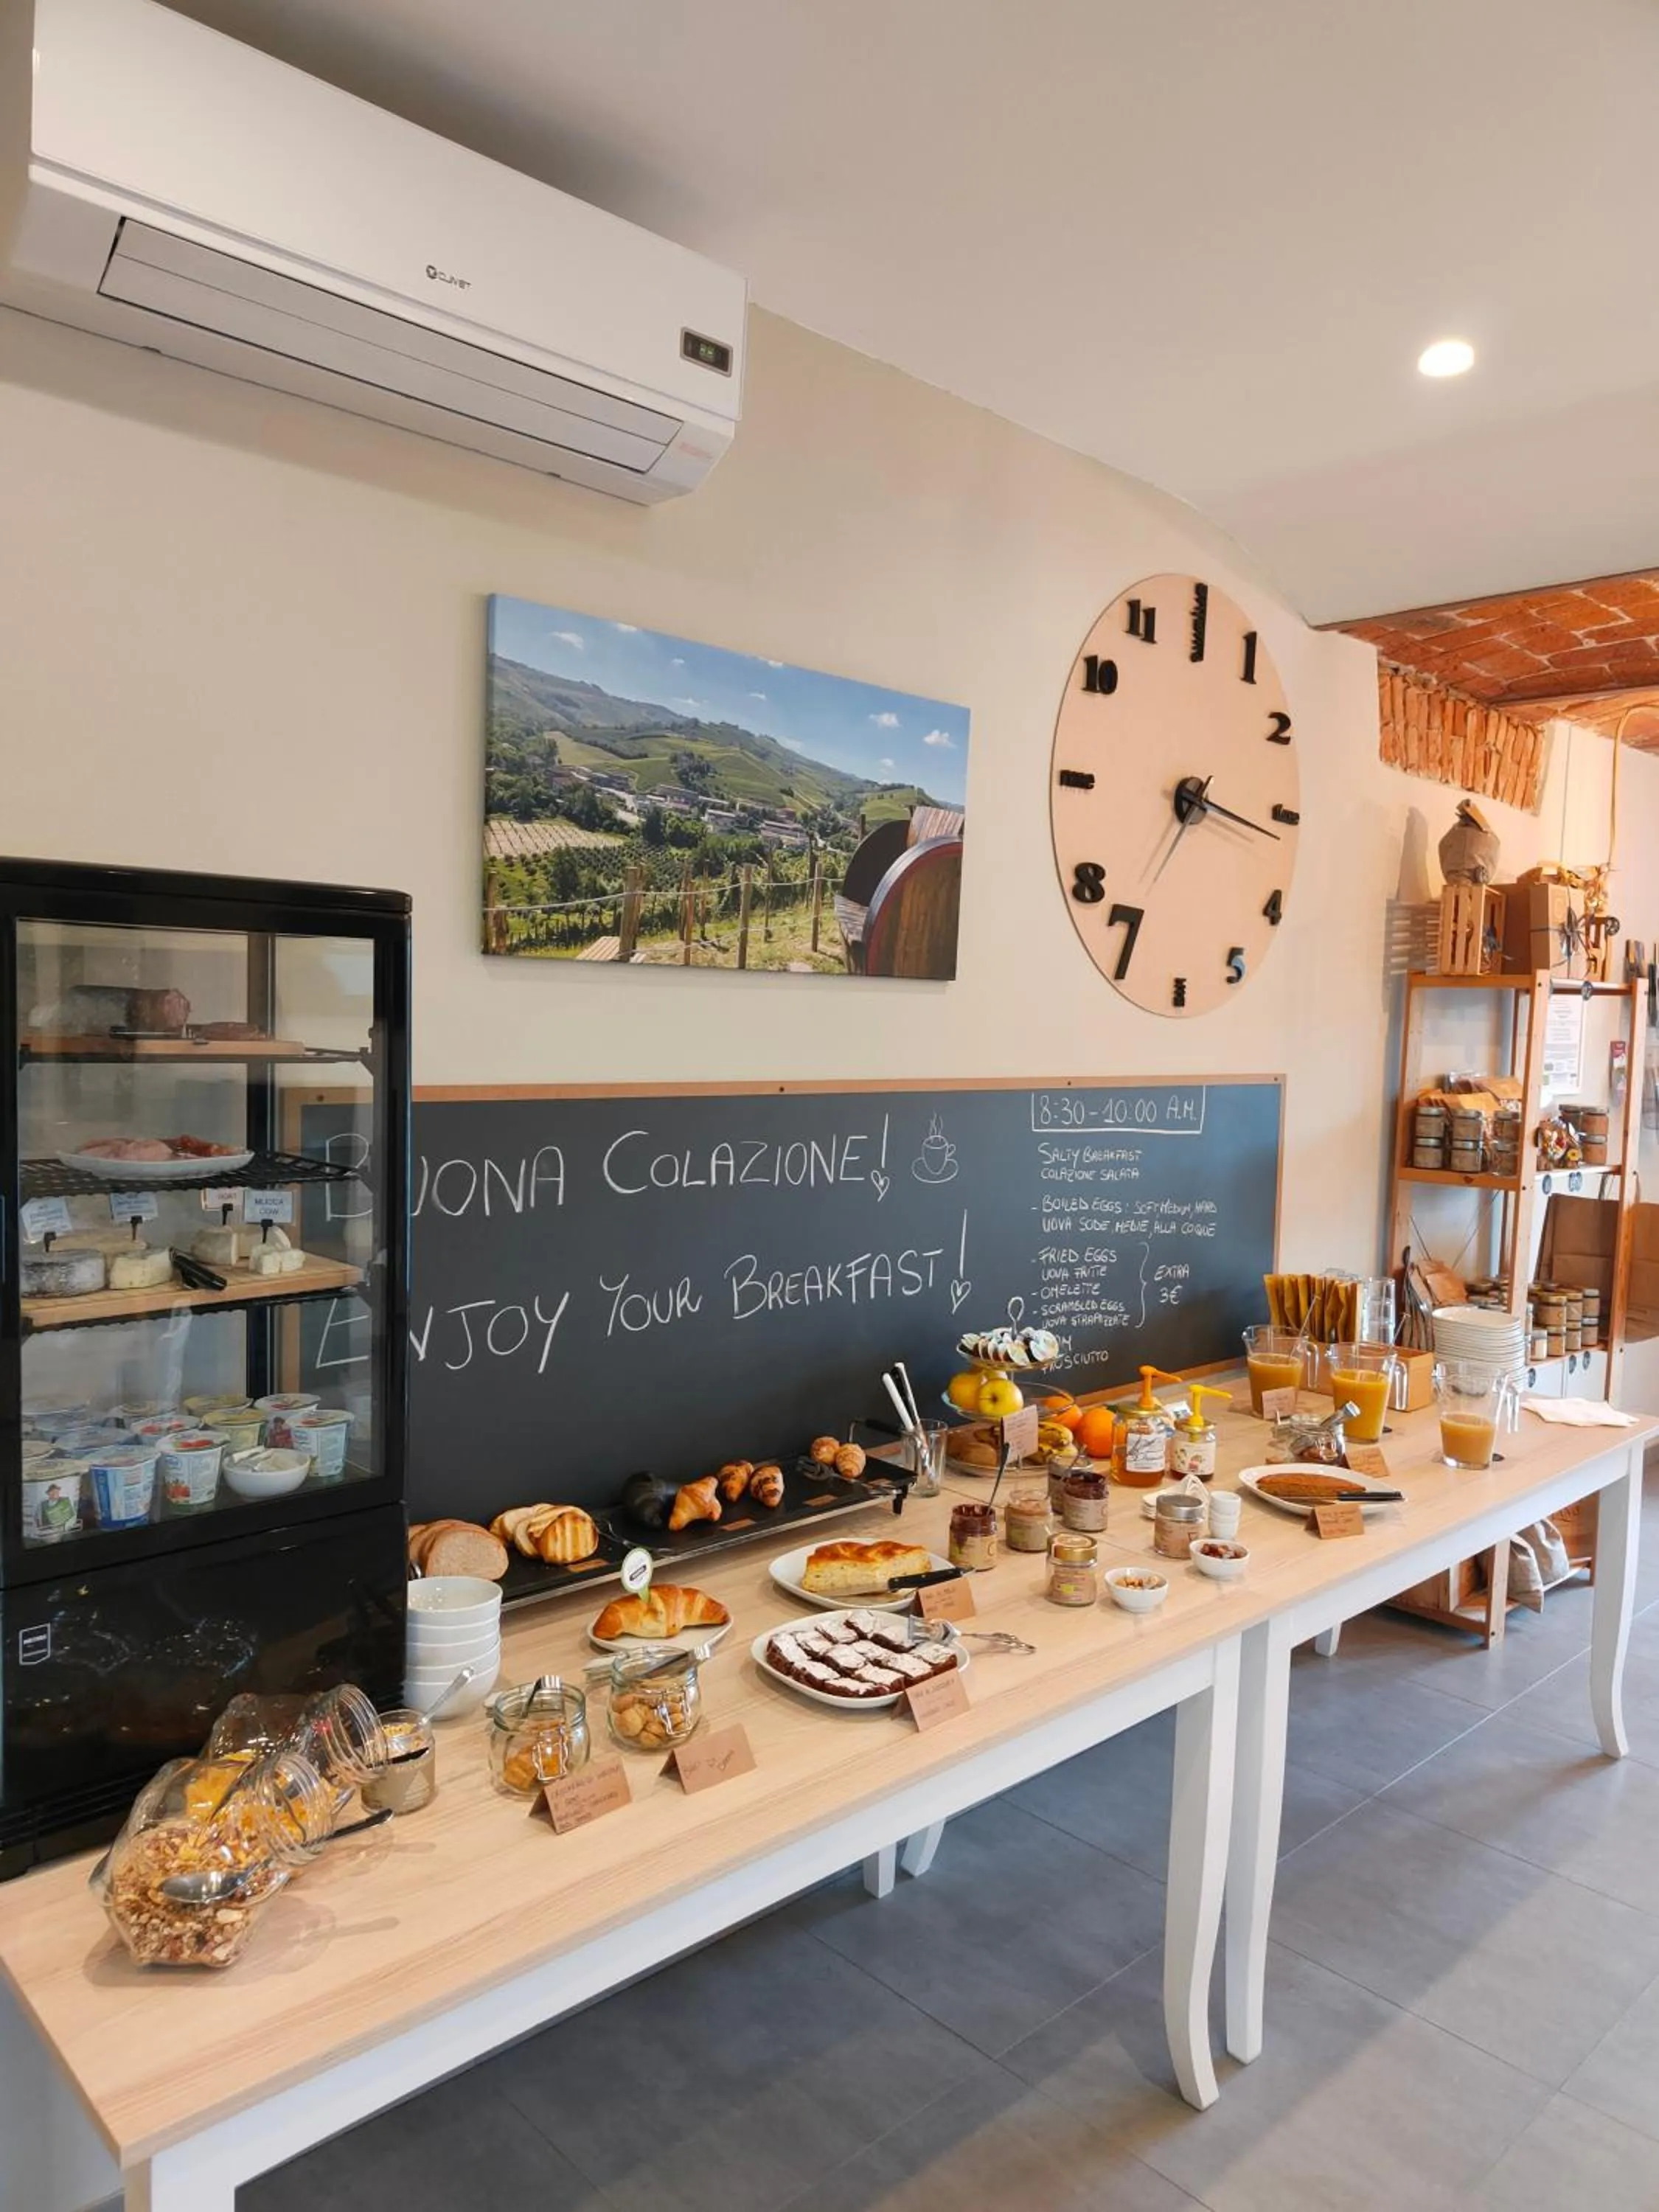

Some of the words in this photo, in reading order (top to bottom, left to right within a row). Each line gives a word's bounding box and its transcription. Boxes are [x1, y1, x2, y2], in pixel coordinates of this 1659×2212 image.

[1124, 599, 1157, 644] 11
[1242, 631, 1257, 684] 1
[1082, 655, 1119, 695] 10
[1267, 712, 1292, 745] 2
[1072, 862, 1106, 903] 8
[1262, 890, 1283, 925] 4
[1107, 904, 1144, 980] 7
[1225, 947, 1246, 984] 5
[1037, 1142, 1080, 1169] SALTY
[1040, 1167, 1097, 1183] COLAZIONE
[1099, 1167, 1140, 1181] SALATA
[1042, 1194, 1090, 1213] BOILED
[1042, 1216, 1071, 1234] UOVA
[1154, 1220, 1176, 1234] ALLA
[1180, 1222, 1217, 1237] COQUE
[1038, 1245, 1079, 1265] FRIED
[1084, 1247, 1118, 1263] EGGS
[1042, 1267, 1069, 1281] UOVA
[1154, 1264, 1190, 1281] EXTRA
[1040, 1282, 1102, 1300] OMELETTE
[1159, 1285, 1183, 1305] 3€
[599, 1273, 703, 1338] YOUR
[1099, 1298, 1126, 1312] EGGS
[1042, 1315, 1067, 1330] UOVA
